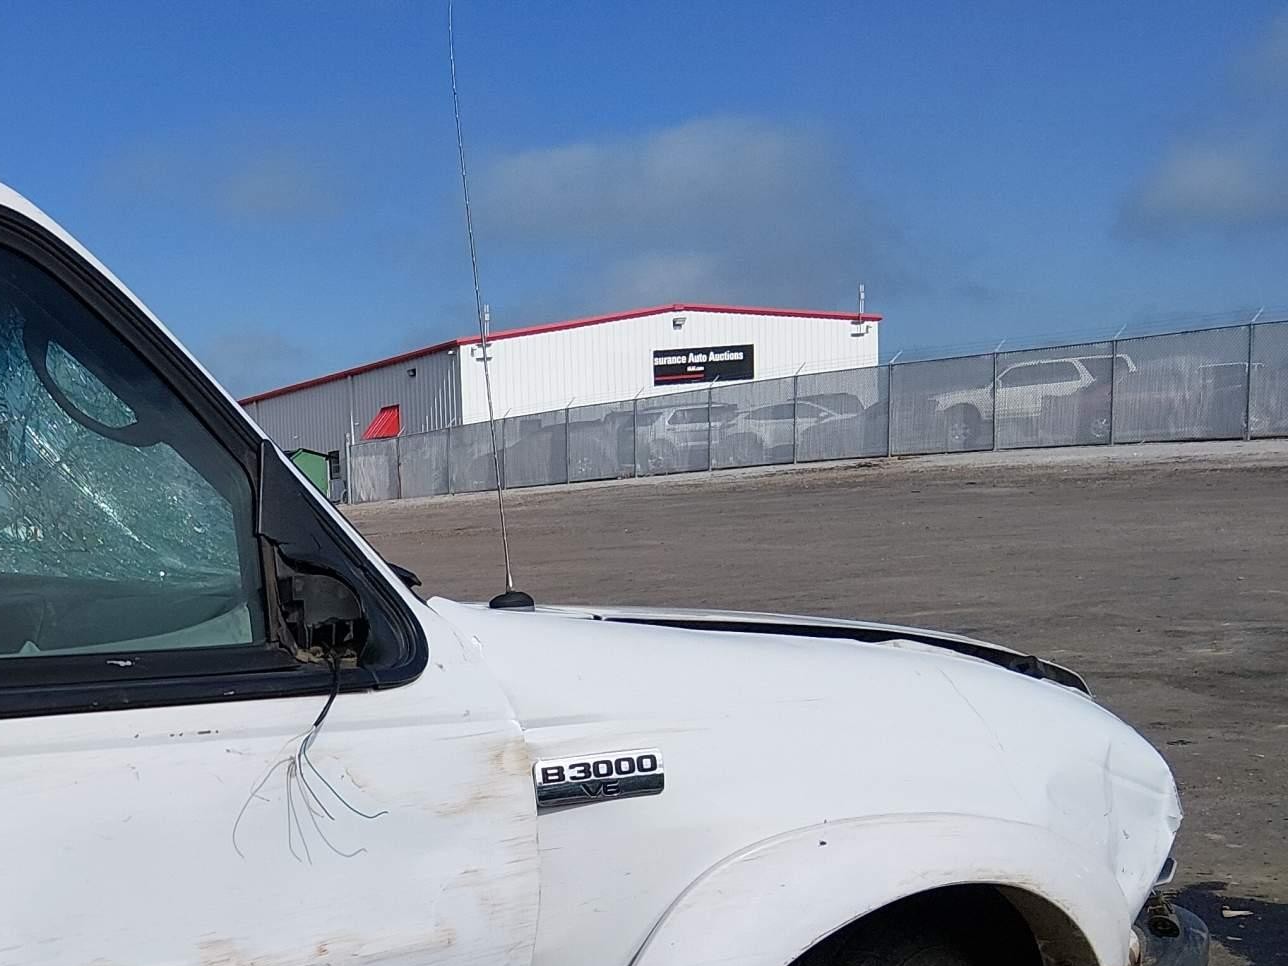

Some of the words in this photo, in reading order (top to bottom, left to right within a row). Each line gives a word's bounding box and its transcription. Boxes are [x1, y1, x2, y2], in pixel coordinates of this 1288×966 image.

[688, 352, 707, 363] Auto
[708, 350, 744, 361] Auctions
[541, 754, 658, 785] B3000
[581, 781, 621, 798] V6
